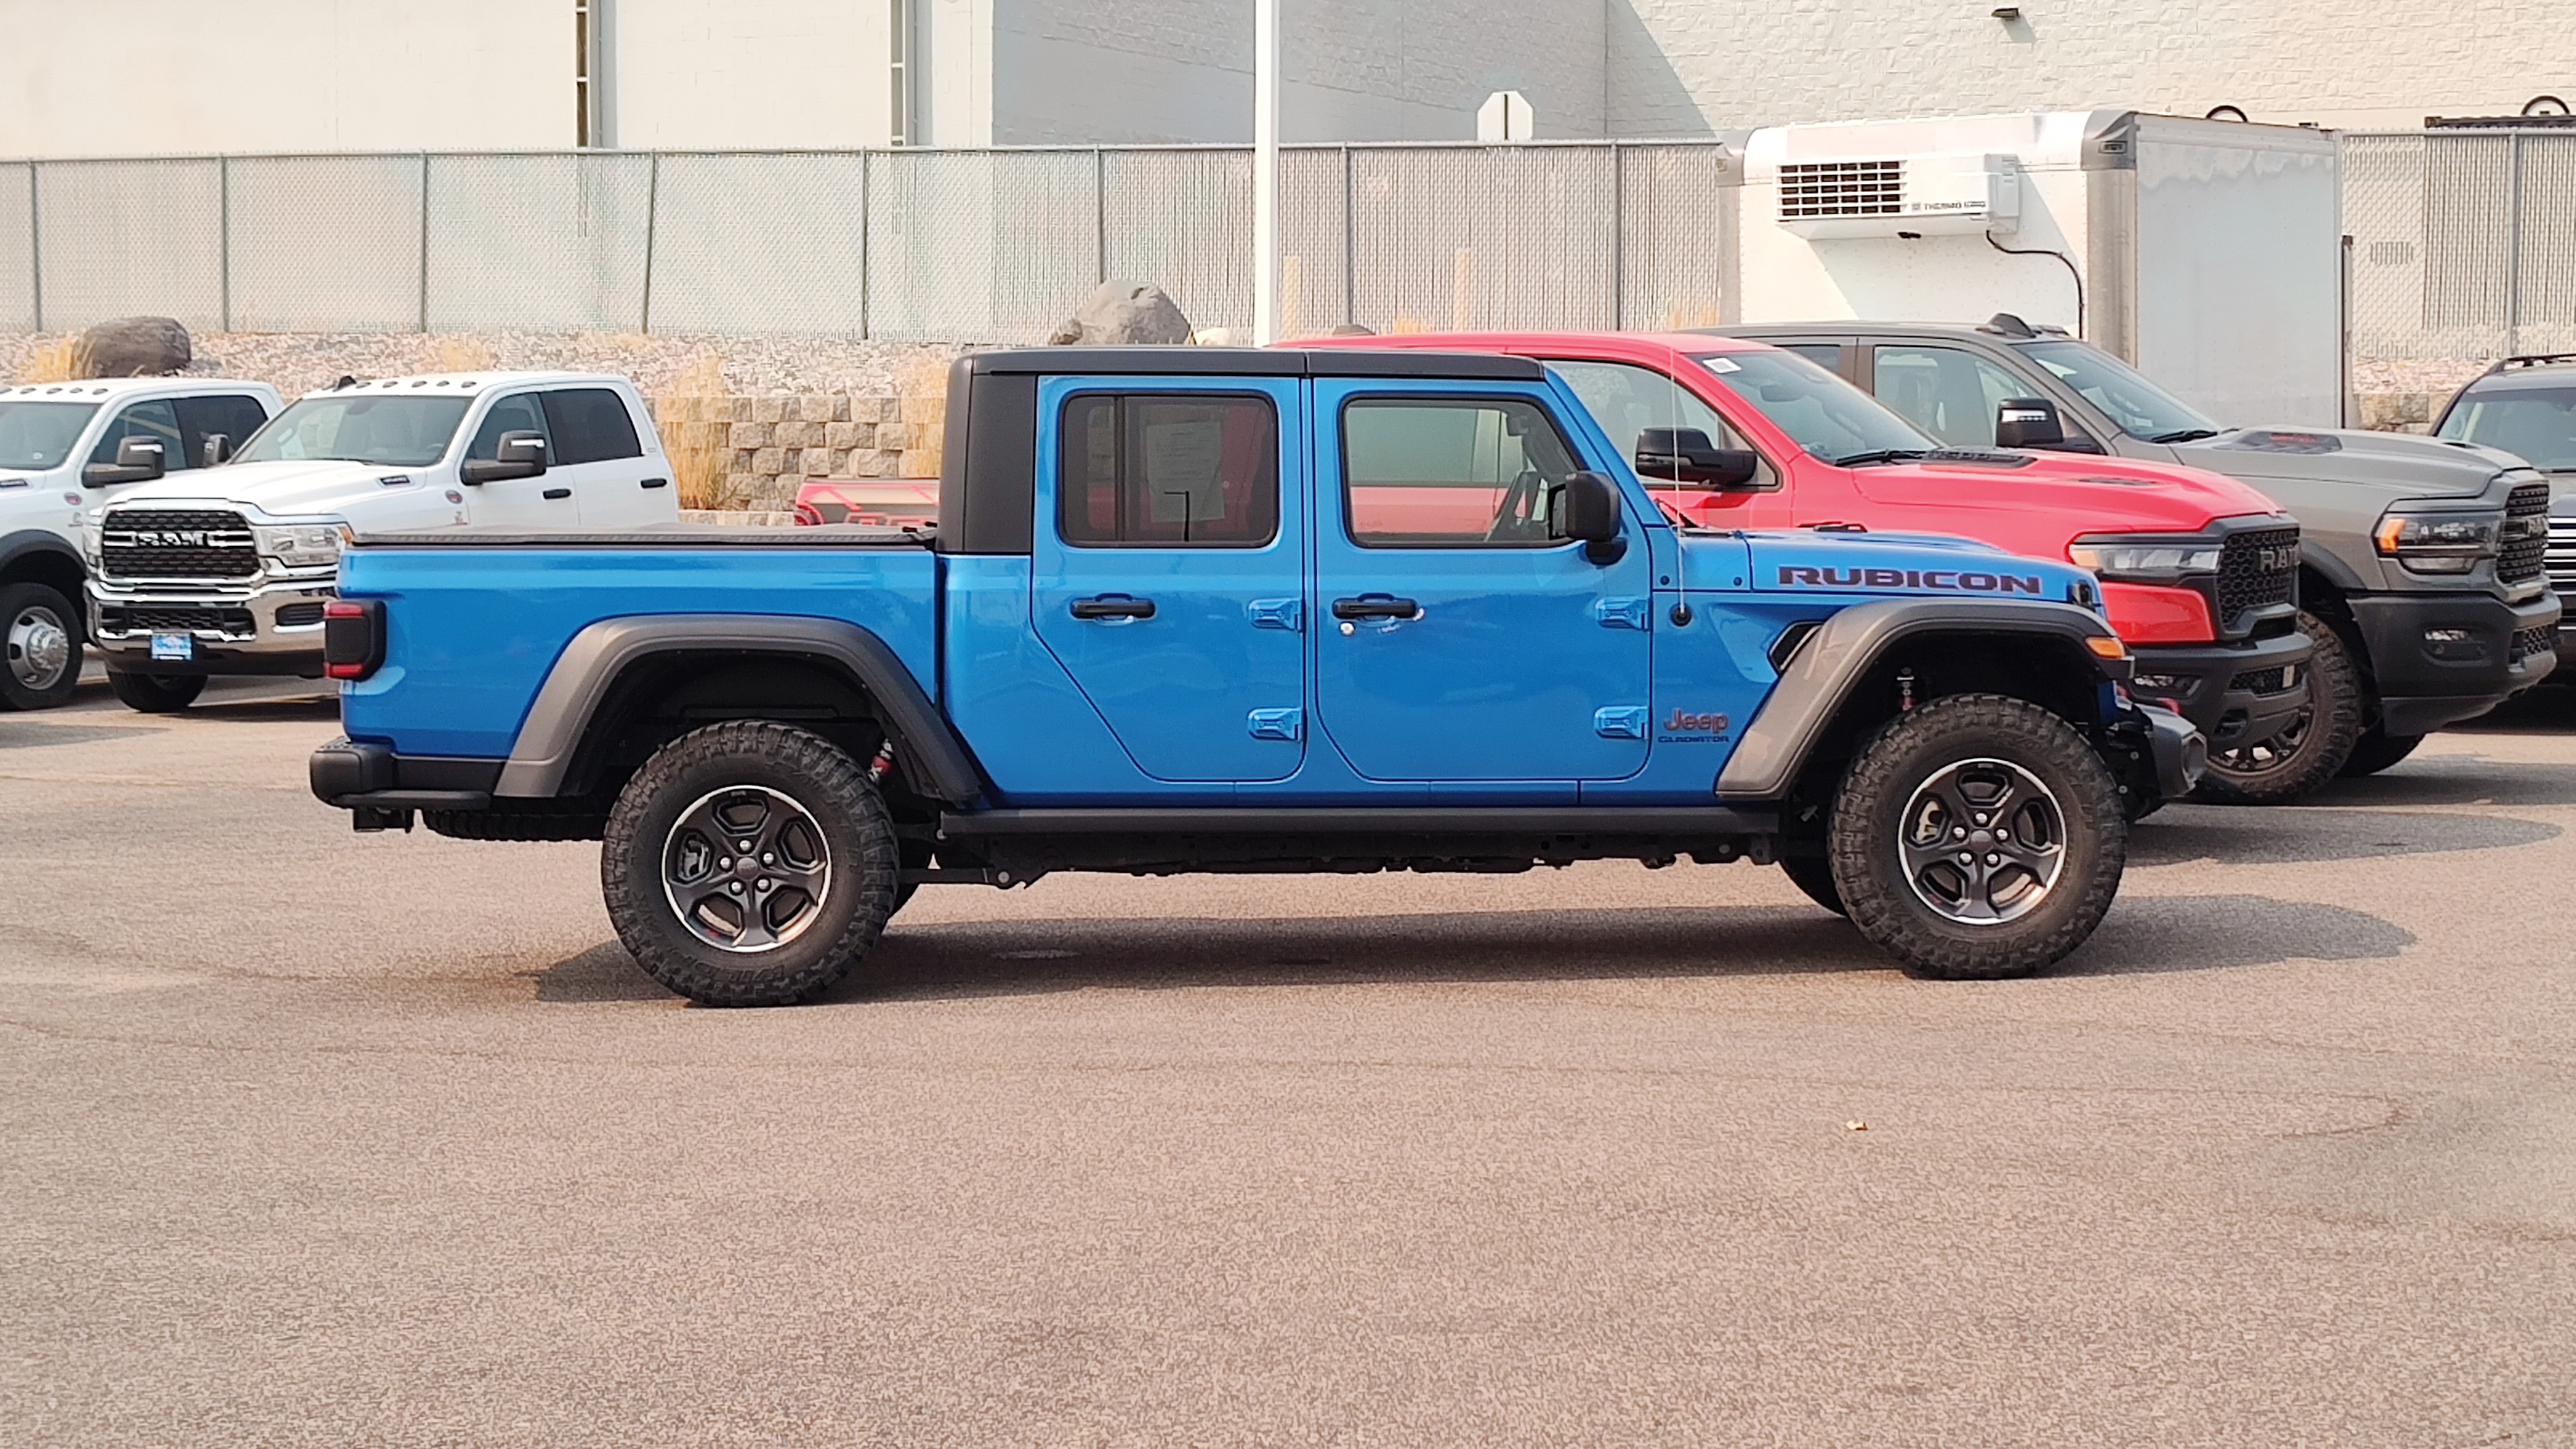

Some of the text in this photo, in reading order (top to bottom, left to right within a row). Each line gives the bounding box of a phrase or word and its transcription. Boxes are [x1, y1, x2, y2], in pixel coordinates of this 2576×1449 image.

[138, 531, 204, 547] RAM
[1778, 565, 2041, 594] RUBICON
[1663, 708, 1729, 735] Jeep
[1657, 735, 1729, 743] GLADIATOR
